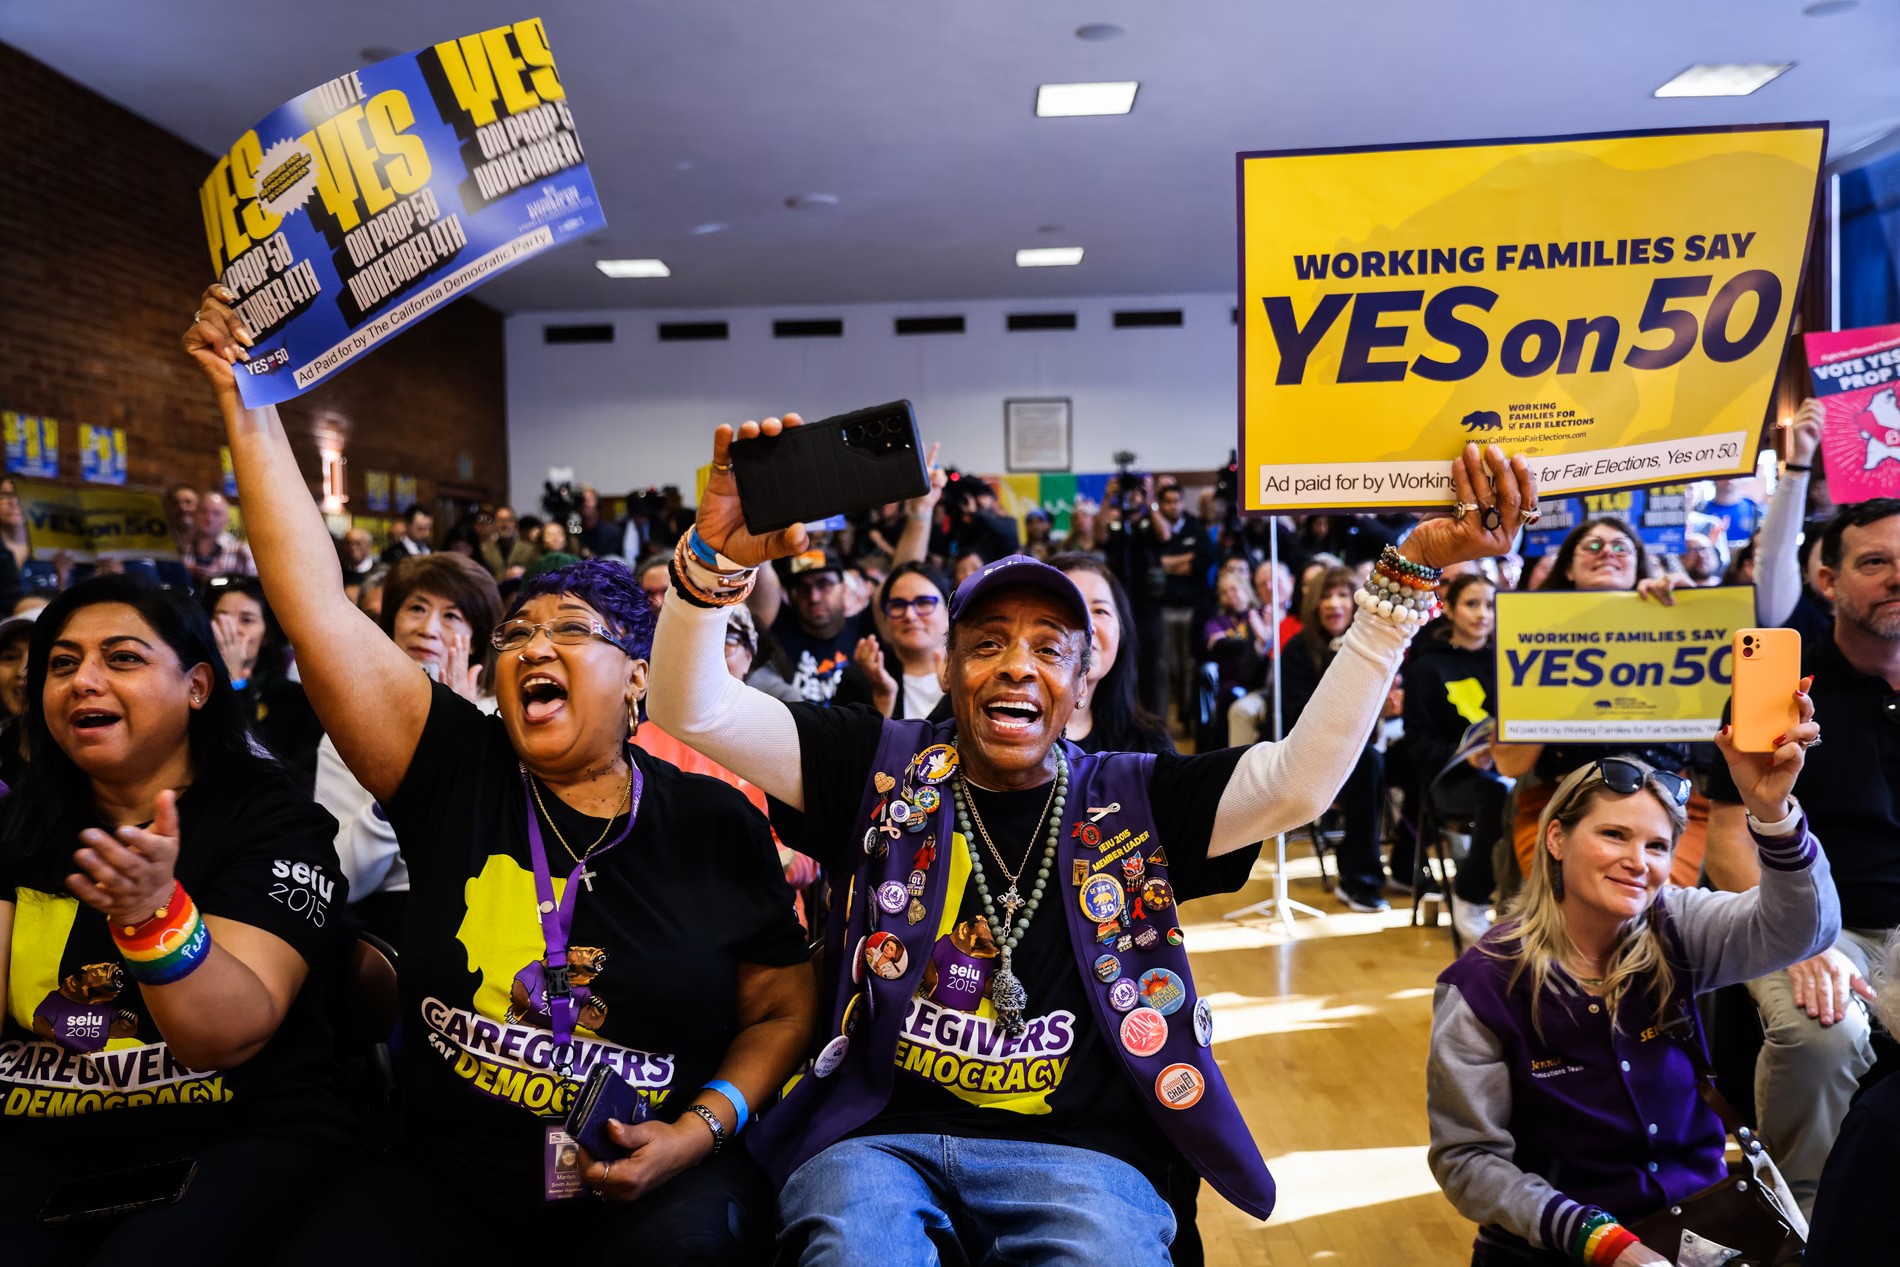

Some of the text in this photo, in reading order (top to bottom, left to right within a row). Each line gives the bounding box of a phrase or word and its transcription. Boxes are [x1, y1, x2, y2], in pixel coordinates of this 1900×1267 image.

[434, 17, 566, 127] YES
[317, 70, 367, 116] VOTE
[476, 100, 575, 160] ON PROP 5
[300, 89, 432, 233] YES
[473, 130, 582, 200] NOVEMBER
[199, 129, 284, 283] YES
[345, 187, 441, 268] ON PROP 50
[226, 231, 294, 300] PROP 50
[347, 214, 468, 312] NOVEMBER 4TH
[1294, 232, 1756, 281] WORKING FAMILIES SAY
[234, 258, 321, 340] EMBER 4TH
[299, 231, 547, 385] Ad Paid for by The California Democratic Party
[1262, 270, 1782, 385] YES on 50
[246, 357, 269, 376] YES
[275, 348, 290, 366] 50
[1814, 357, 1865, 380] VOTE
[1865, 347, 1900, 370] YES
[1839, 366, 1892, 390] PROP
[1509, 402, 1556, 412] WORKING
[1509, 410, 1575, 421] FAMILIES FOR
[1519, 418, 1595, 430] FAIR ELECTIONS
[1466, 431, 1587, 445] www.CaliforniaFairElections.com
[1540, 466, 1561, 482] for
[1563, 461, 1593, 479] Fair
[1594, 454, 1661, 475] Elections,
[1667, 449, 1692, 465] Yes
[1695, 448, 1714, 461] on
[1717, 442, 1739, 460] 50.
[1266, 475, 1289, 492] Ad
[1295, 474, 1330, 495] paid
[1336, 474, 1359, 490] for
[1364, 473, 1385, 494] by
[1518, 629, 1727, 644] WORKING FAMILIES SAY
[1506, 648, 1607, 687] YES
[1610, 662, 1664, 687] on
[1091, 830, 1150, 872] MEMBER LEADER
[1099, 828, 1132, 854] SEIU 2015
[272, 859, 335, 903] seiu
[1097, 884, 1110, 892] YES
[268, 883, 327, 927] 2015
[1100, 903, 1114, 914] 50
[946, 976, 977, 994] 2015
[950, 963, 980, 981] seiu
[1148, 983, 1176, 1004] JACKIE
[1152, 989, 1180, 1009] FIELDER
[66, 1012, 103, 1027] seiu
[66, 1026, 101, 1038] 2015
[424, 1001, 673, 1083] CAREGIVERS
[428, 1032, 456, 1061] for
[894, 1041, 1071, 1091] EMOCRACY
[1167, 1083, 1188, 1100] CHAN
